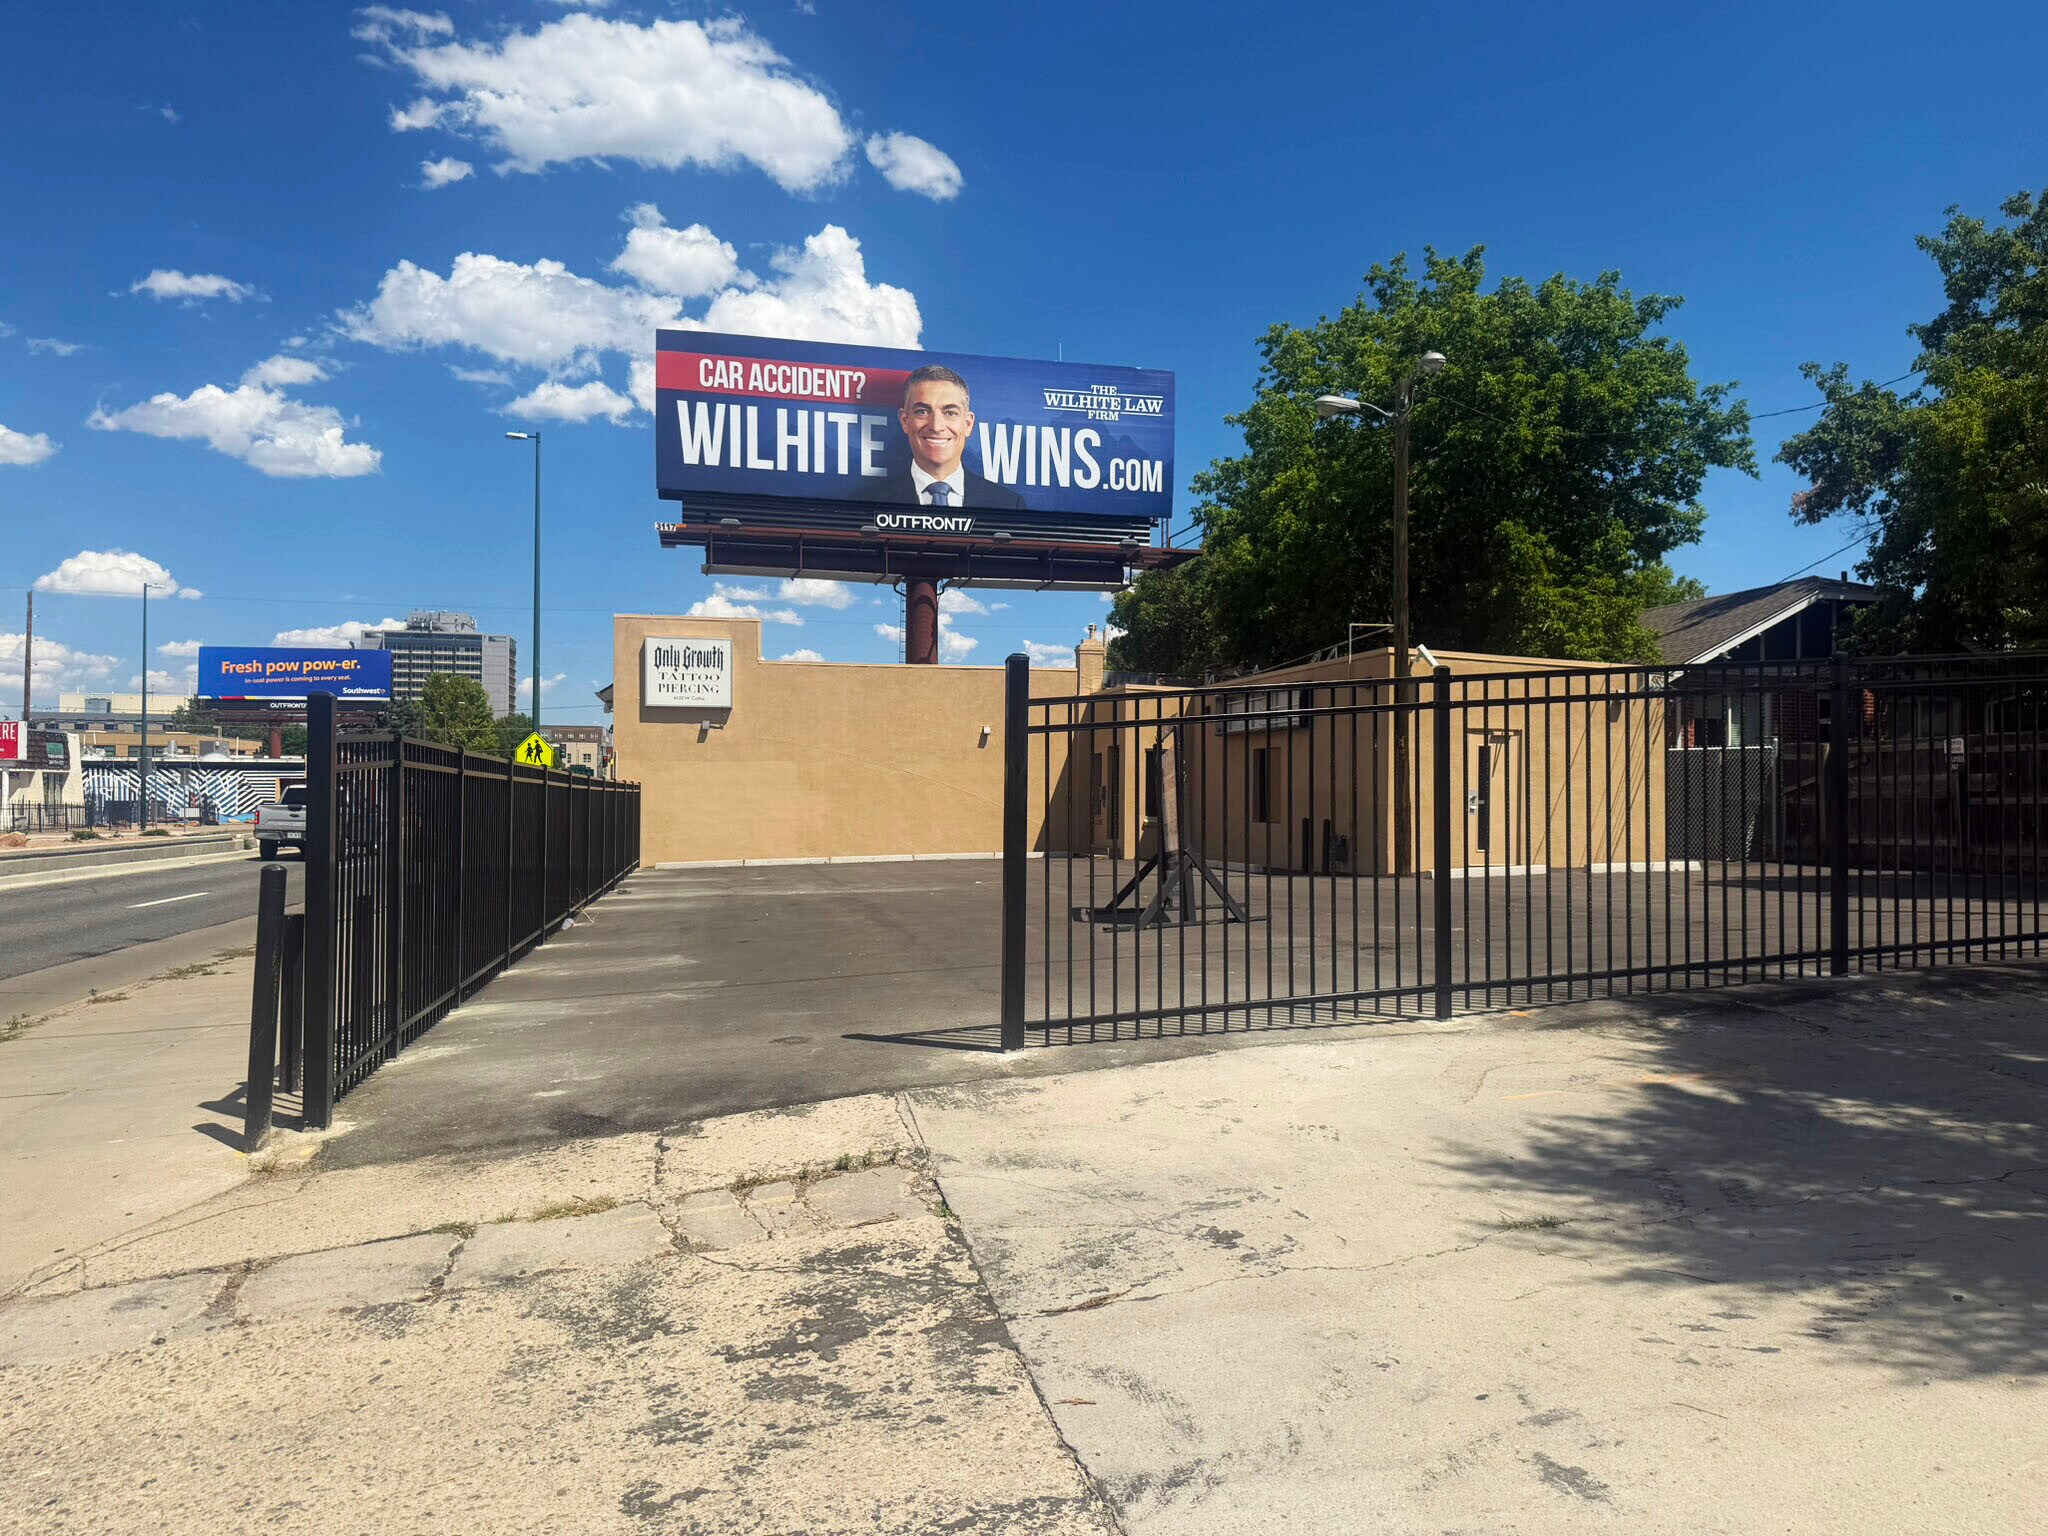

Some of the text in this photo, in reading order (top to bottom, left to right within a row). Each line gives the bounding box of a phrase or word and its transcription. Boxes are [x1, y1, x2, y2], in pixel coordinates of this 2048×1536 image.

[699, 358, 866, 399] CAR ACCIDENT?
[1091, 385, 1117, 395] THE
[1043, 392, 1163, 413] WILHITE LAW
[1088, 410, 1119, 420] FIRM
[676, 400, 888, 477] WILHITE
[655, 522, 676, 531] 3117
[654, 644, 724, 672] Only Growth
[222, 659, 360, 676] Fresh pow pow-er.
[658, 672, 720, 682] TATTOO
[342, 687, 380, 695] Southwest
[658, 683, 719, 694] PIERCING
[0, 722, 17, 740] RE
